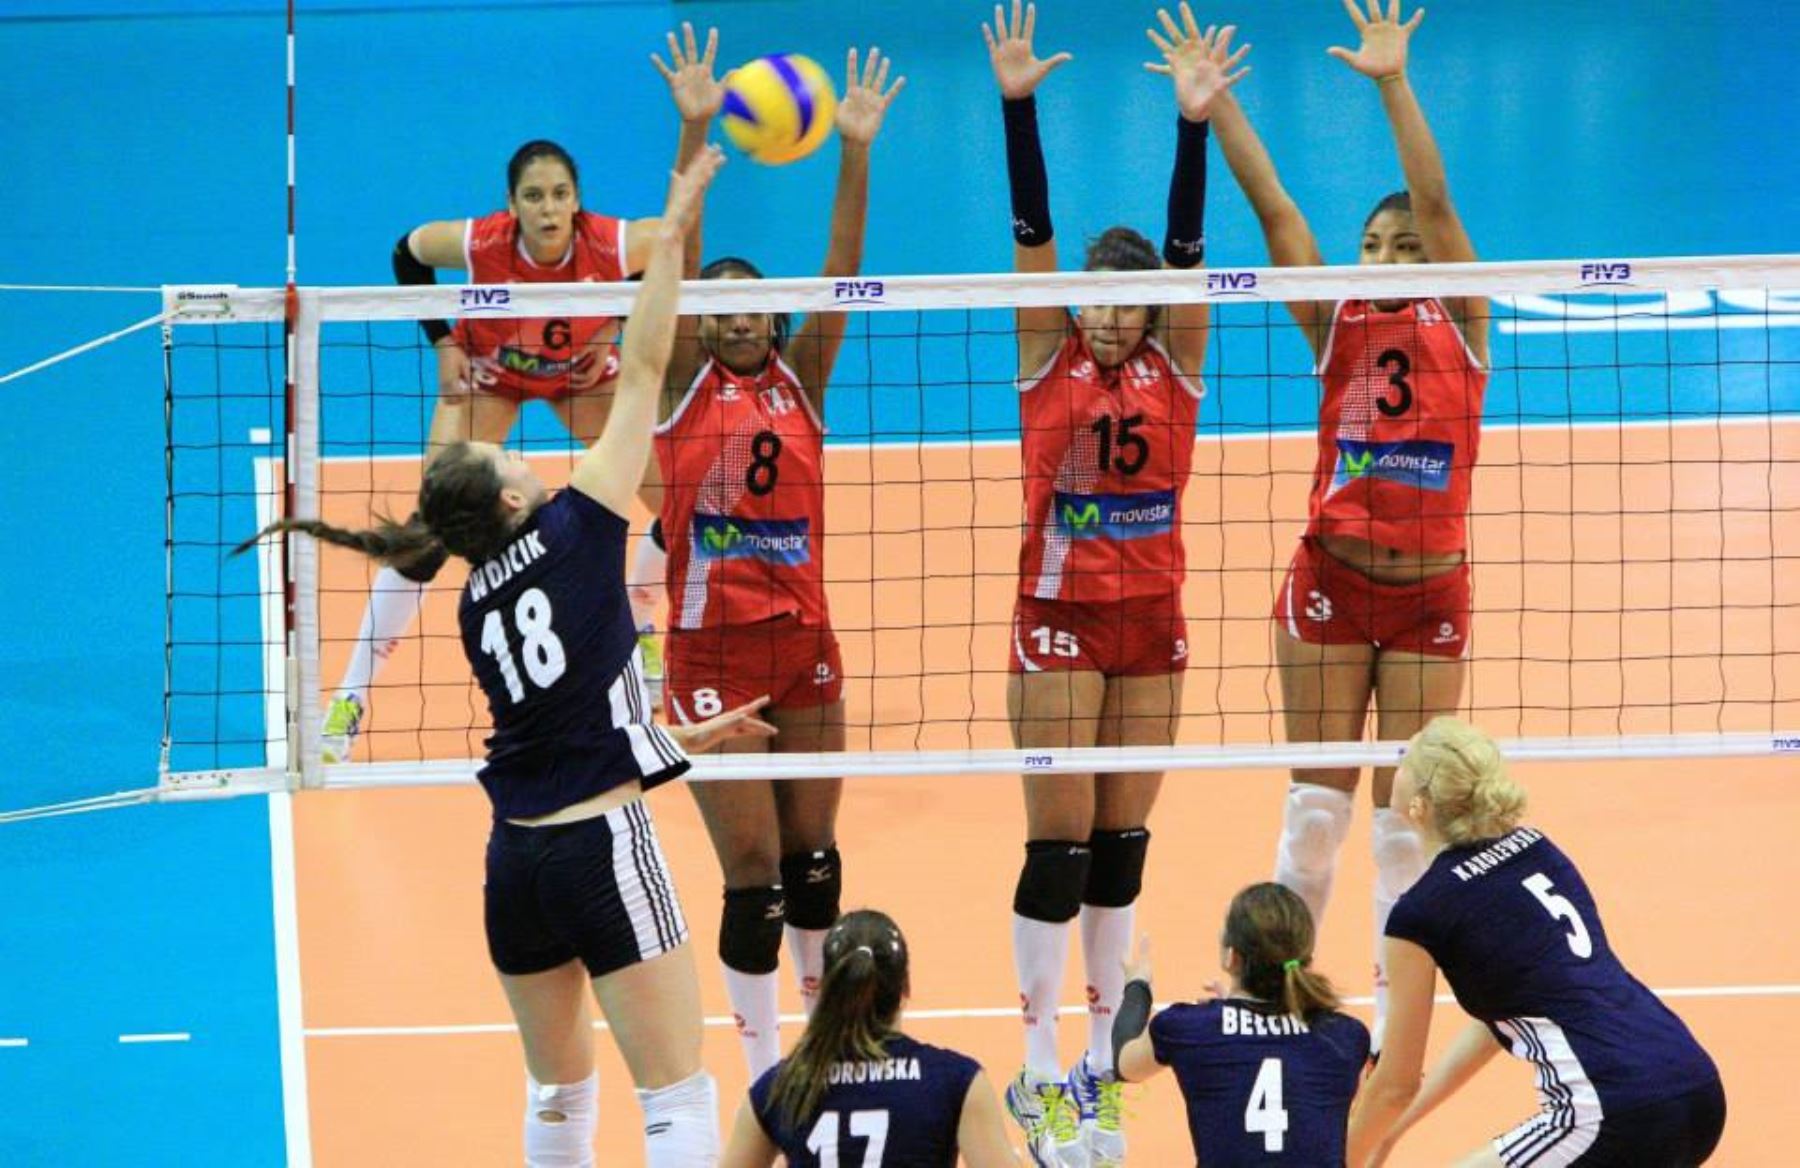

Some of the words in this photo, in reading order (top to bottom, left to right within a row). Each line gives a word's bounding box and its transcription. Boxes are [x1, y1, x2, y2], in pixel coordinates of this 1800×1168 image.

[1207, 273, 1257, 289] FIVB
[1581, 264, 1631, 280] FIVB
[461, 289, 510, 304] FIVB
[835, 282, 884, 297] FIVB
[543, 319, 571, 349] 6
[1376, 349, 1412, 417] 3
[1092, 413, 1149, 476] 15
[746, 431, 782, 496] 8
[1109, 503, 1172, 523] movistar
[745, 533, 807, 551] movistar
[1306, 590, 1333, 621] 3
[481, 587, 567, 704] 18
[1030, 626, 1081, 658] 15
[692, 687, 723, 718] 8
[1025, 756, 1053, 766] FIVB
[1521, 872, 1593, 959] 5
[828, 1056, 922, 1085] OROWSKA
[1244, 1057, 1289, 1152] 4
[806, 1109, 890, 1168] 17
